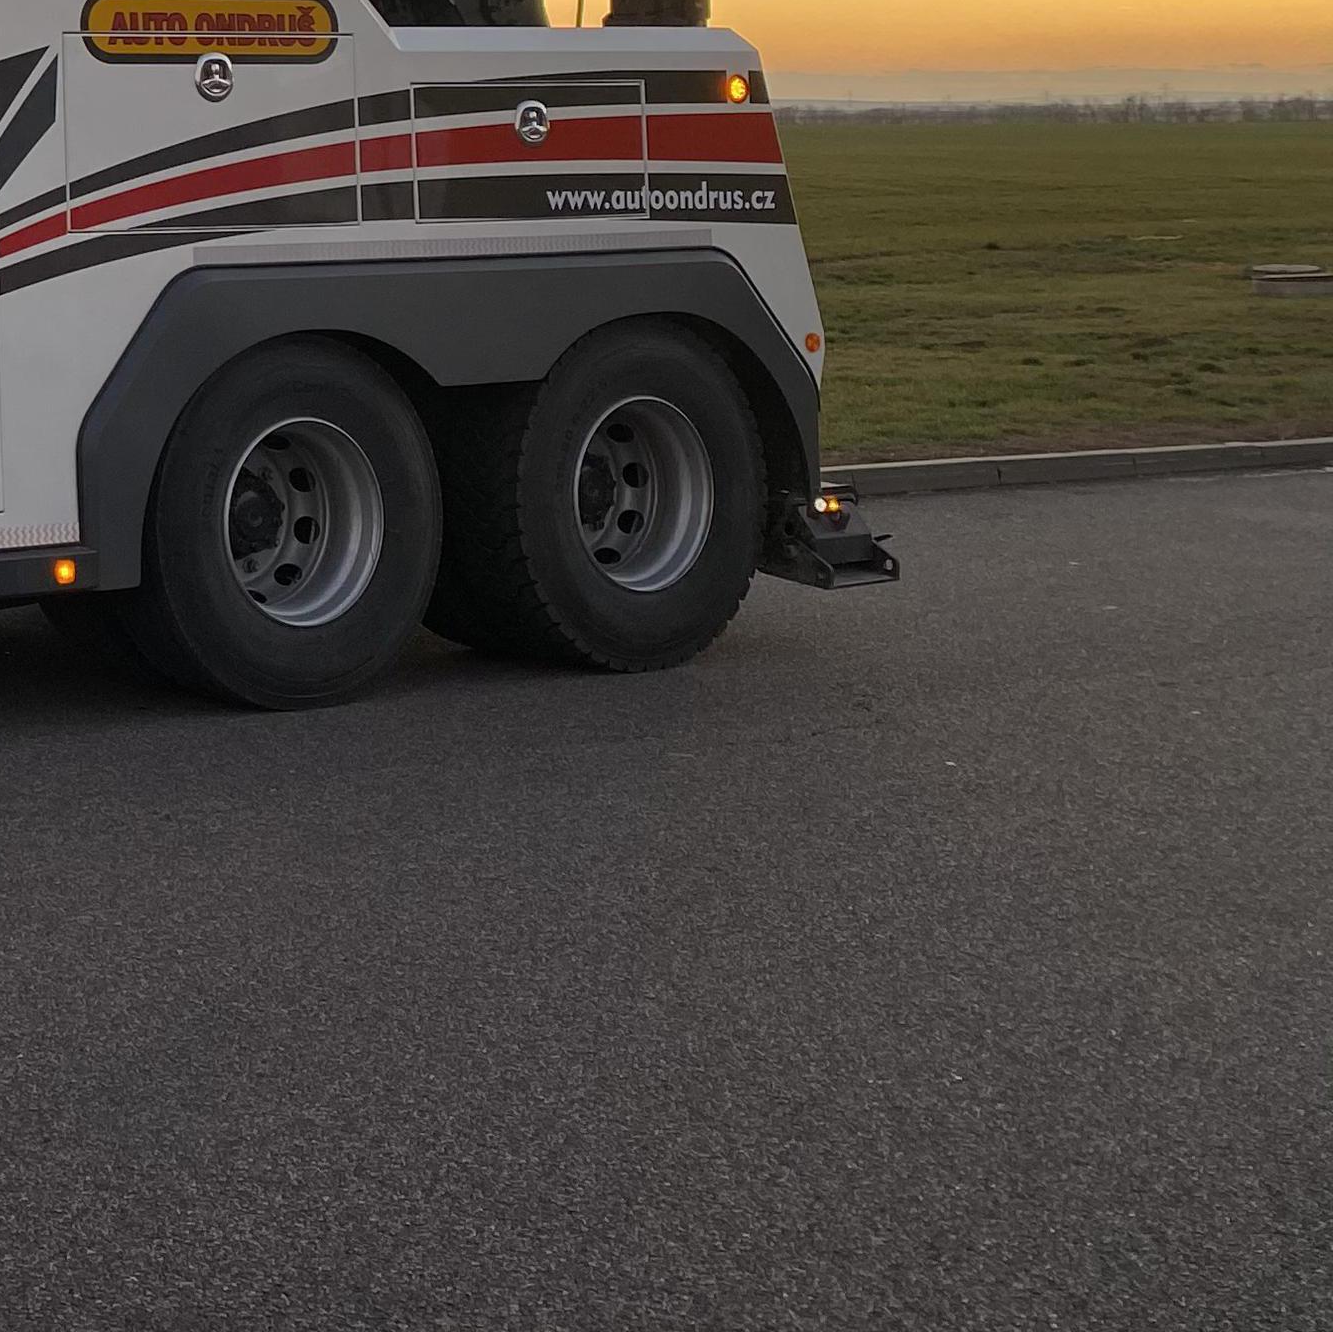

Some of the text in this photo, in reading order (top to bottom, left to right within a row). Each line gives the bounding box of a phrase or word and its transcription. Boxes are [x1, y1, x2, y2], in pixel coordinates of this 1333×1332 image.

[108, 6, 317, 47] AUTO ONDRUŠ
[546, 180, 776, 211] www.autoondrus.cz
